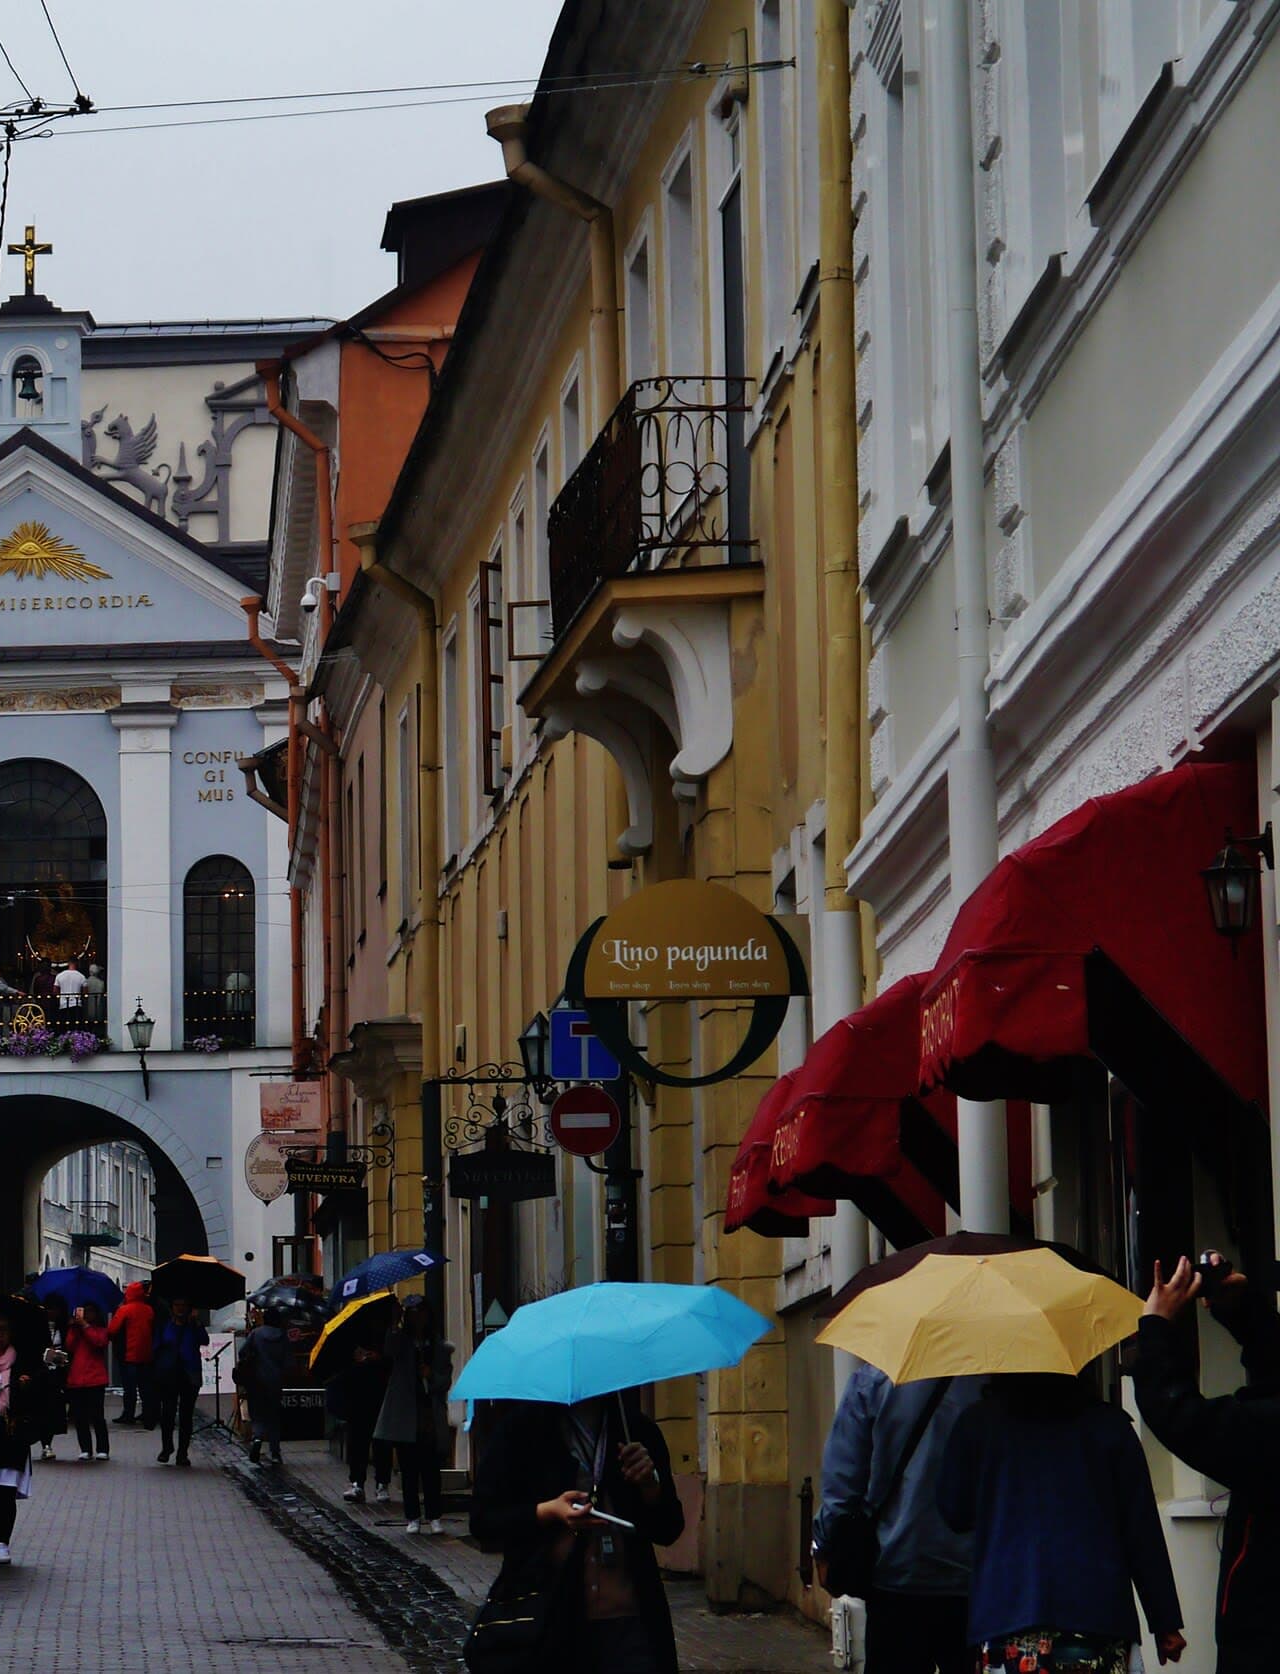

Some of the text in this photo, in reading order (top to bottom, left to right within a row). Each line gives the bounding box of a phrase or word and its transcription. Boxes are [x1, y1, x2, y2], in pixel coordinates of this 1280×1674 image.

[183, 751, 244, 765] CONFU
[204, 768, 224, 782] GI
[198, 789, 233, 802] MUS
[602, 937, 768, 972] Lino pagunda
